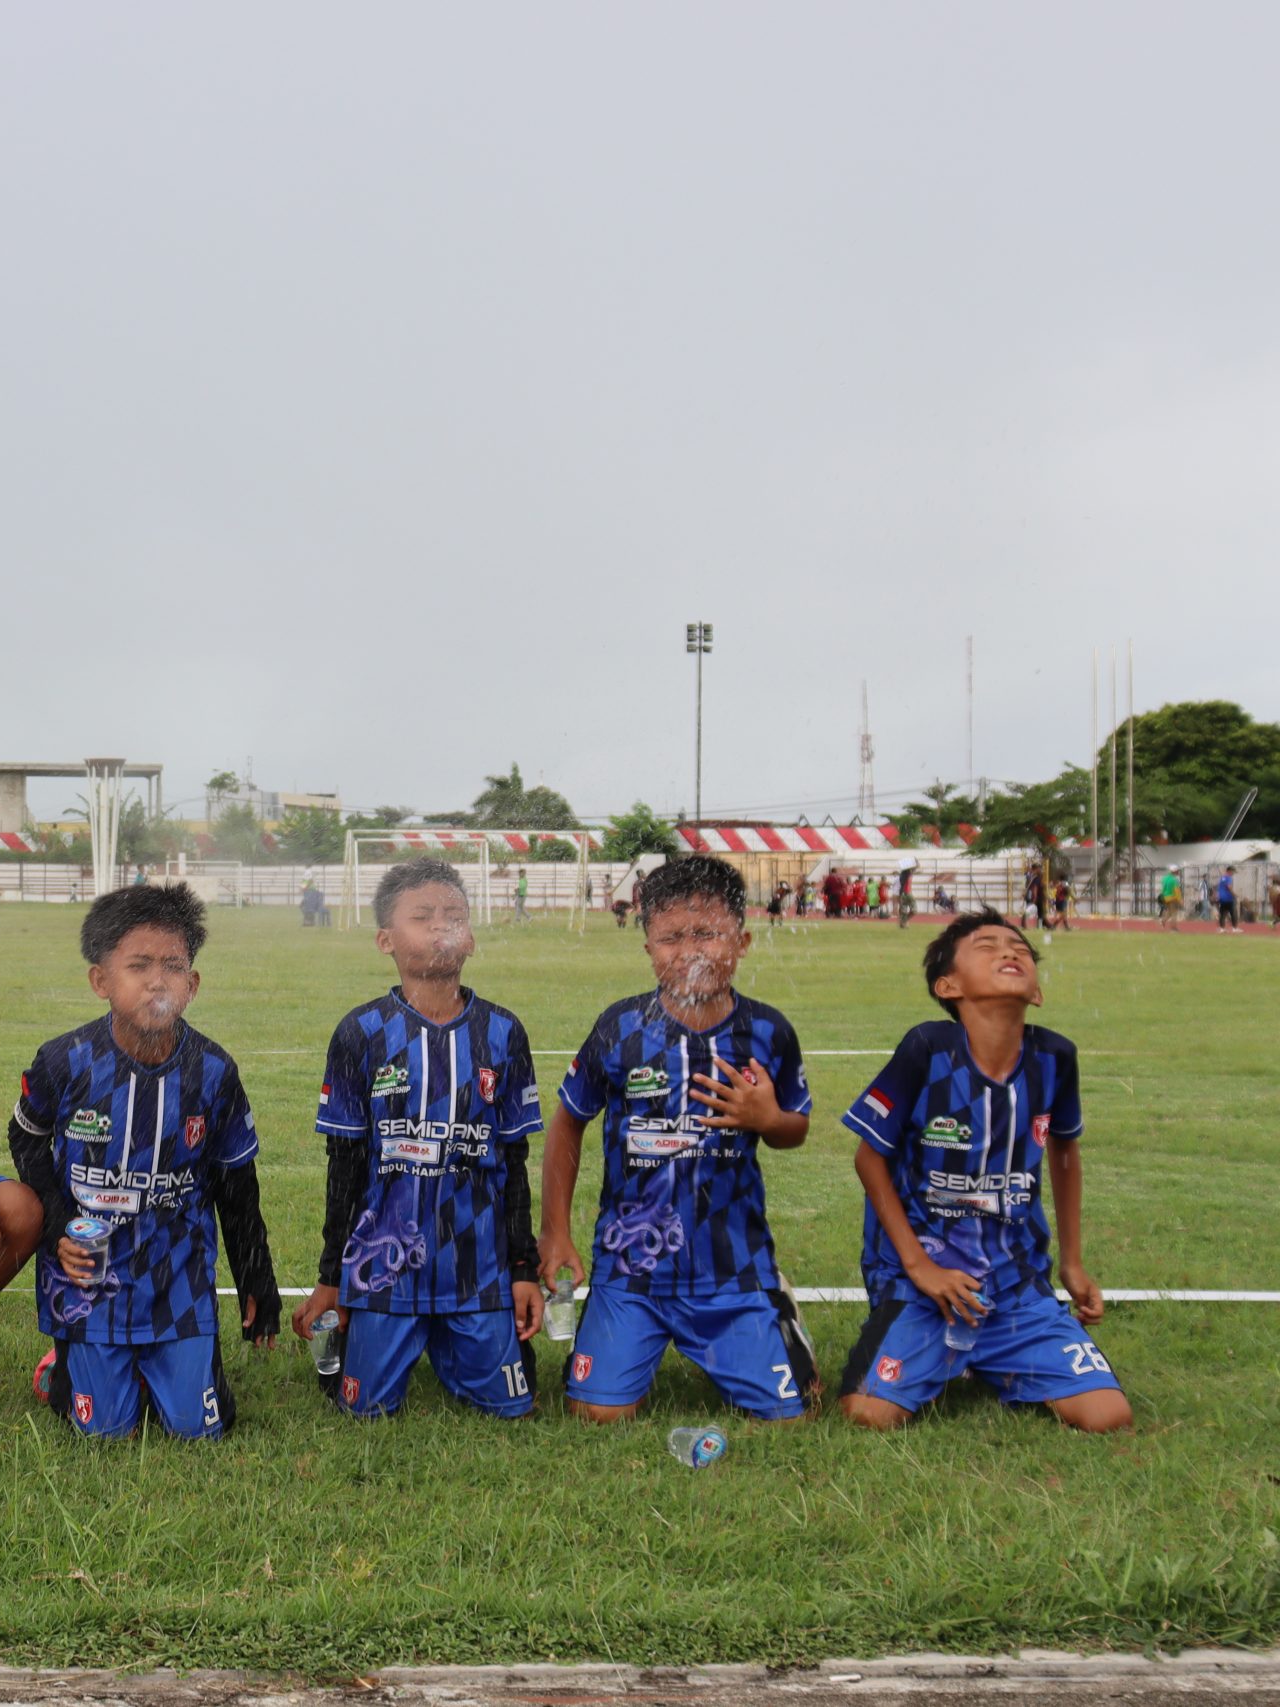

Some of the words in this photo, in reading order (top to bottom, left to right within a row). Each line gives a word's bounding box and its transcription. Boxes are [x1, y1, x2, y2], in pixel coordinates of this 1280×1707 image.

[371, 1085, 412, 1098] AMPIONSHIP
[378, 1118, 492, 1141] SEMIDANG
[933, 1121, 956, 1130] MILO
[920, 1138, 973, 1151] CHAMPIONSHIP
[628, 1158, 663, 1168] ABDU
[674, 1149, 708, 1159] MID,
[502, 1361, 529, 1398] 16
[772, 1364, 797, 1399] 2
[203, 1387, 220, 1427] 5
